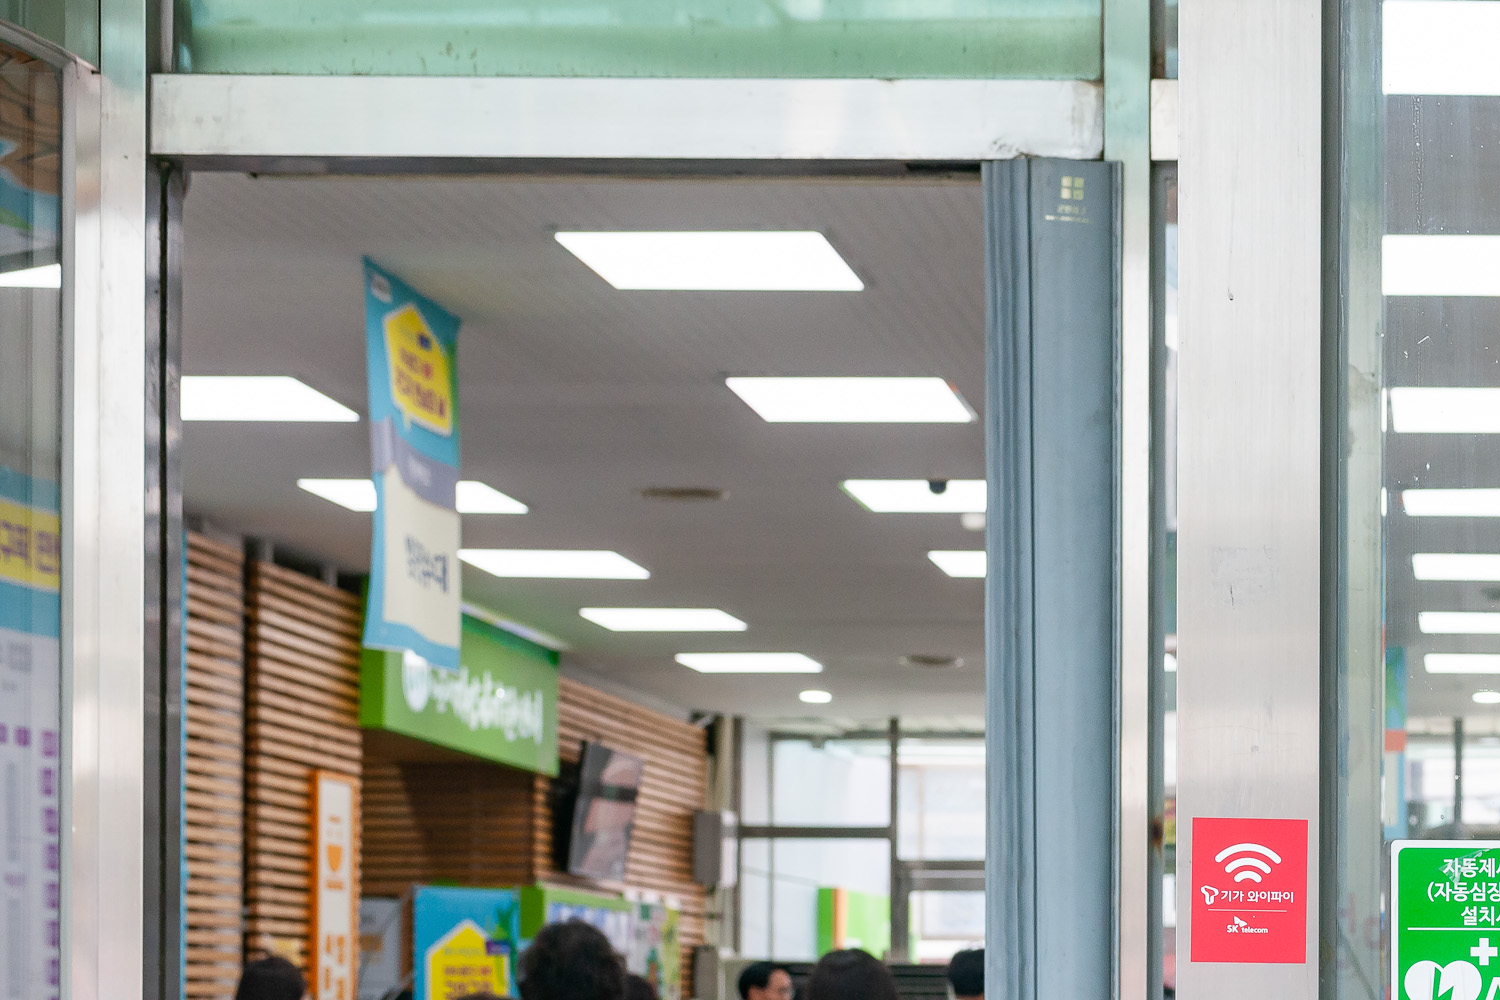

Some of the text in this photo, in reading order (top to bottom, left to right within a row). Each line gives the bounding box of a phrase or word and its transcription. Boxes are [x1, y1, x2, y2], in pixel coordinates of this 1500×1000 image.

[1220, 890, 1244, 903] 기가
[1247, 891, 1294, 904] 와이파이
[1226, 924, 1269, 934] SK telecom
